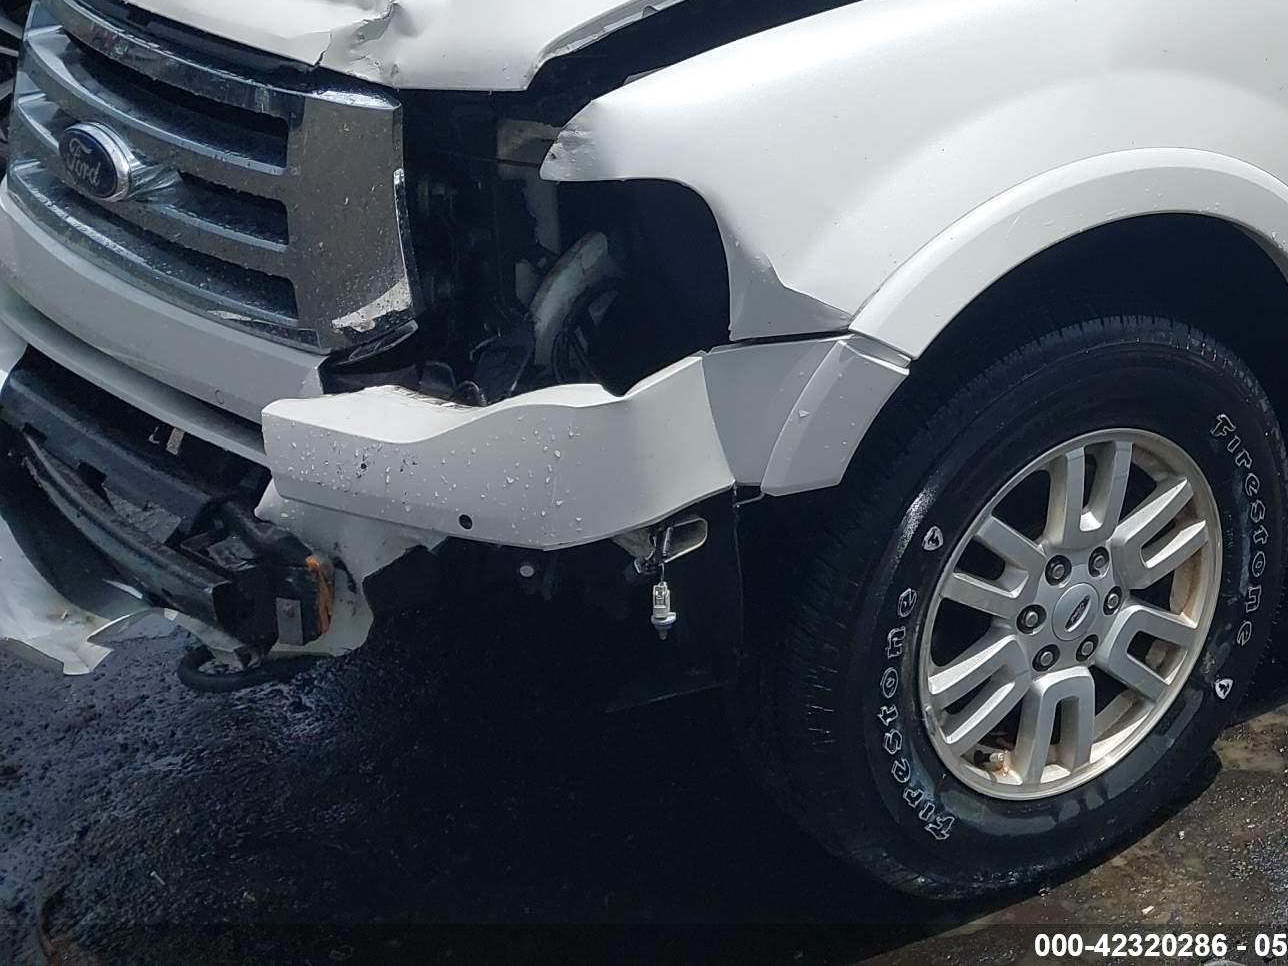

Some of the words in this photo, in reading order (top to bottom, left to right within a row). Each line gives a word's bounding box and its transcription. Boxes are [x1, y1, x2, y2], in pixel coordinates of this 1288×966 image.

[65, 137, 102, 188] Ford
[1210, 413, 1268, 647] Firestone
[877, 586, 956, 842] Firestone
